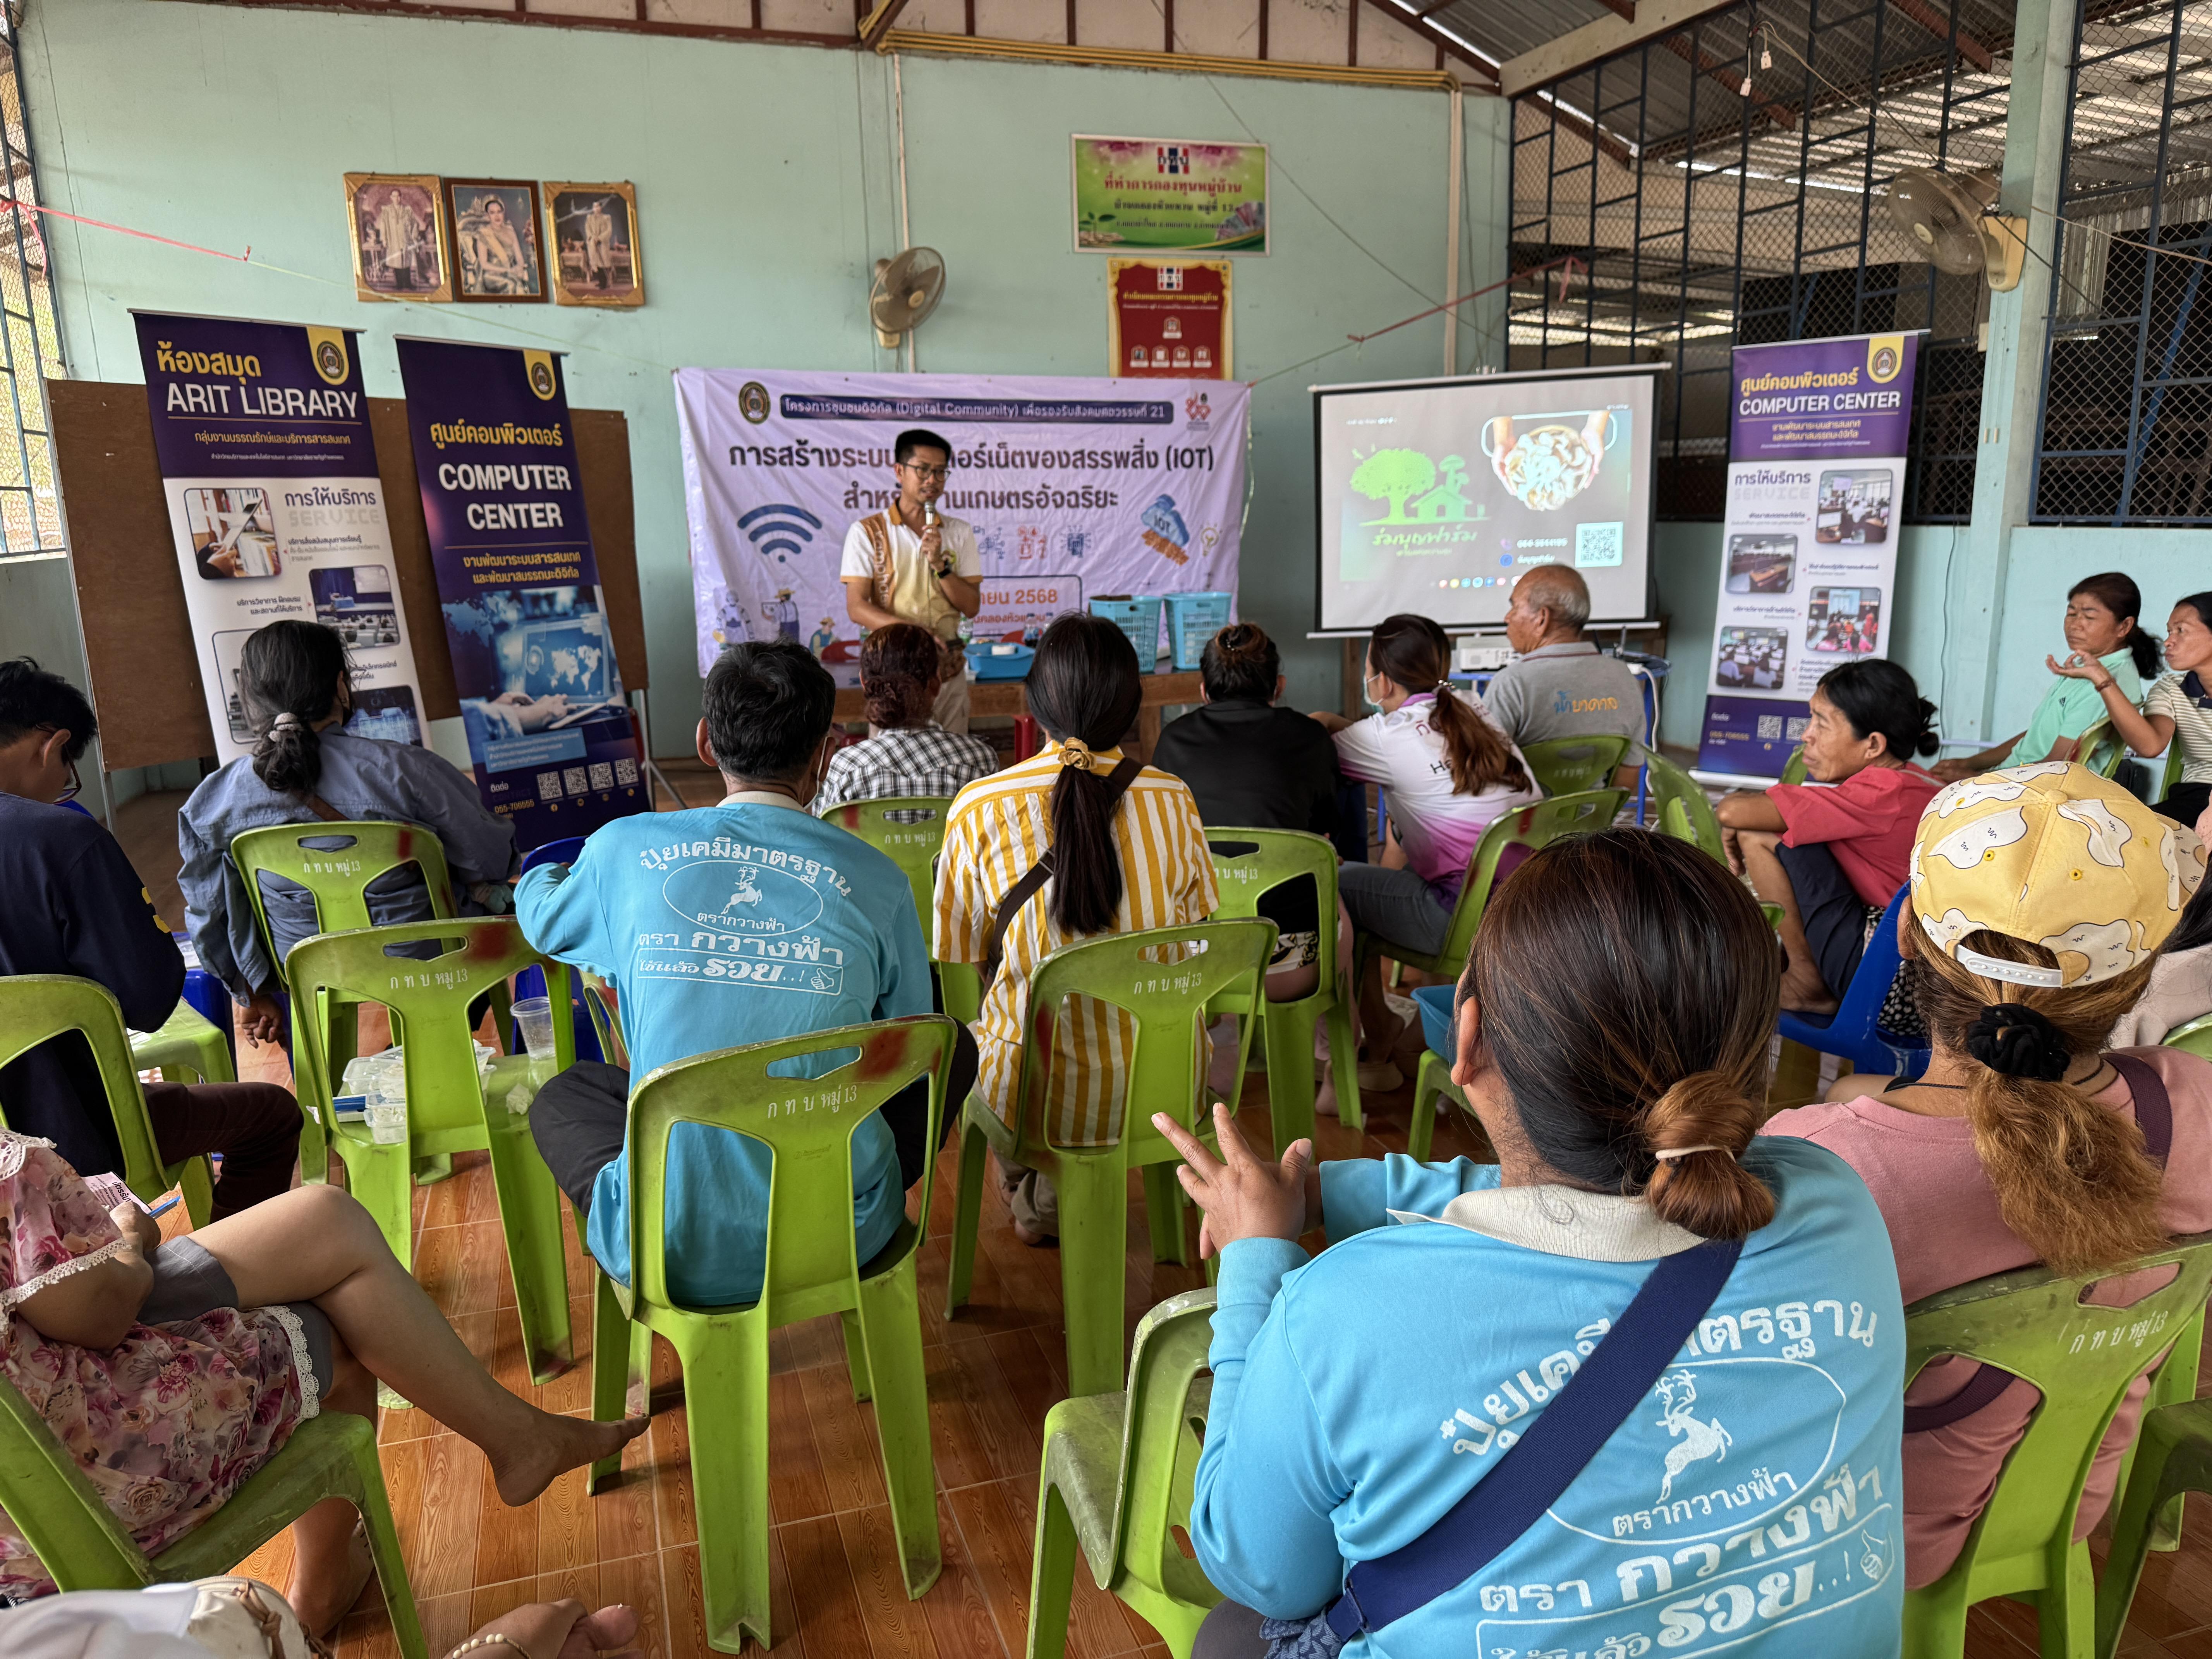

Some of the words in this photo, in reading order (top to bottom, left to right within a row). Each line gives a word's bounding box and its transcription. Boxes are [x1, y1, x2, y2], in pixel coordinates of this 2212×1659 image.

[157, 340, 262, 385] ห้องสมุด
[1740, 367, 1859, 397] ศูนย์คอมพิวเตอร์
[167, 383, 231, 414] ARIT
[239, 385, 358, 418] LIBRARY
[784, 398, 891, 417] โครงการชุมชนดิจิทัล
[895, 400, 941, 418] (Digital
[944, 402, 1019, 419] Community)
[1150, 405, 1165, 418] 21
[1739, 395, 1829, 416] COMPUTER
[1833, 390, 1901, 411] CENTER
[430, 419, 564, 450] ศูนย์คอมพิวเตอร์
[1165, 445, 1215, 471] (IOT)
[439, 463, 572, 491] COMPUTER
[1735, 469, 1812, 486] การให้บริการ
[285, 486, 376, 507] การให้บริการ
[288, 508, 380, 527] SERVICE
[467, 502, 564, 530] CENTER
[1015, 588, 1058, 605] 2568
[490, 781, 509, 793] ติดต่อ
[304, 862, 310, 873] ก
[313, 861, 322, 873] ท
[324, 862, 333, 872] บ
[639, 836, 852, 897] ปุ๋ยเคมีมาตรฐาน
[697, 912, 785, 932] ตรากวางฟ้า
[639, 933, 679, 946] ตรา
[692, 931, 843, 965] กวางฟ้า
[390, 976, 398, 989] ก
[404, 975, 414, 988] ท
[420, 973, 430, 986] บ
[435, 969, 453, 990] หมู่
[457, 968, 468, 982] 13
[639, 959, 700, 974] ใช้แล้ว
[1134, 980, 1142, 994] ก
[1147, 978, 1156, 993] ท
[1161, 977, 1170, 991] บ
[1174, 971, 1190, 994] หมู่
[1191, 972, 1202, 987] 13
[768, 1102, 778, 1118] ก
[785, 1099, 797, 1115] ท
[803, 1096, 814, 1112] บ
[821, 1085, 841, 1113] หมู่
[844, 1085, 857, 1104] 13
[2069, 1334, 2085, 1355] ก
[2089, 1331, 2107, 1351] ท
[2110, 1325, 2126, 1346] บ
[1612, 1466, 1797, 1538] ตรากวางฟ้า
[1479, 1578, 1594, 1613] ตรา
[1616, 1463, 1885, 1603] กวางฟ้า
